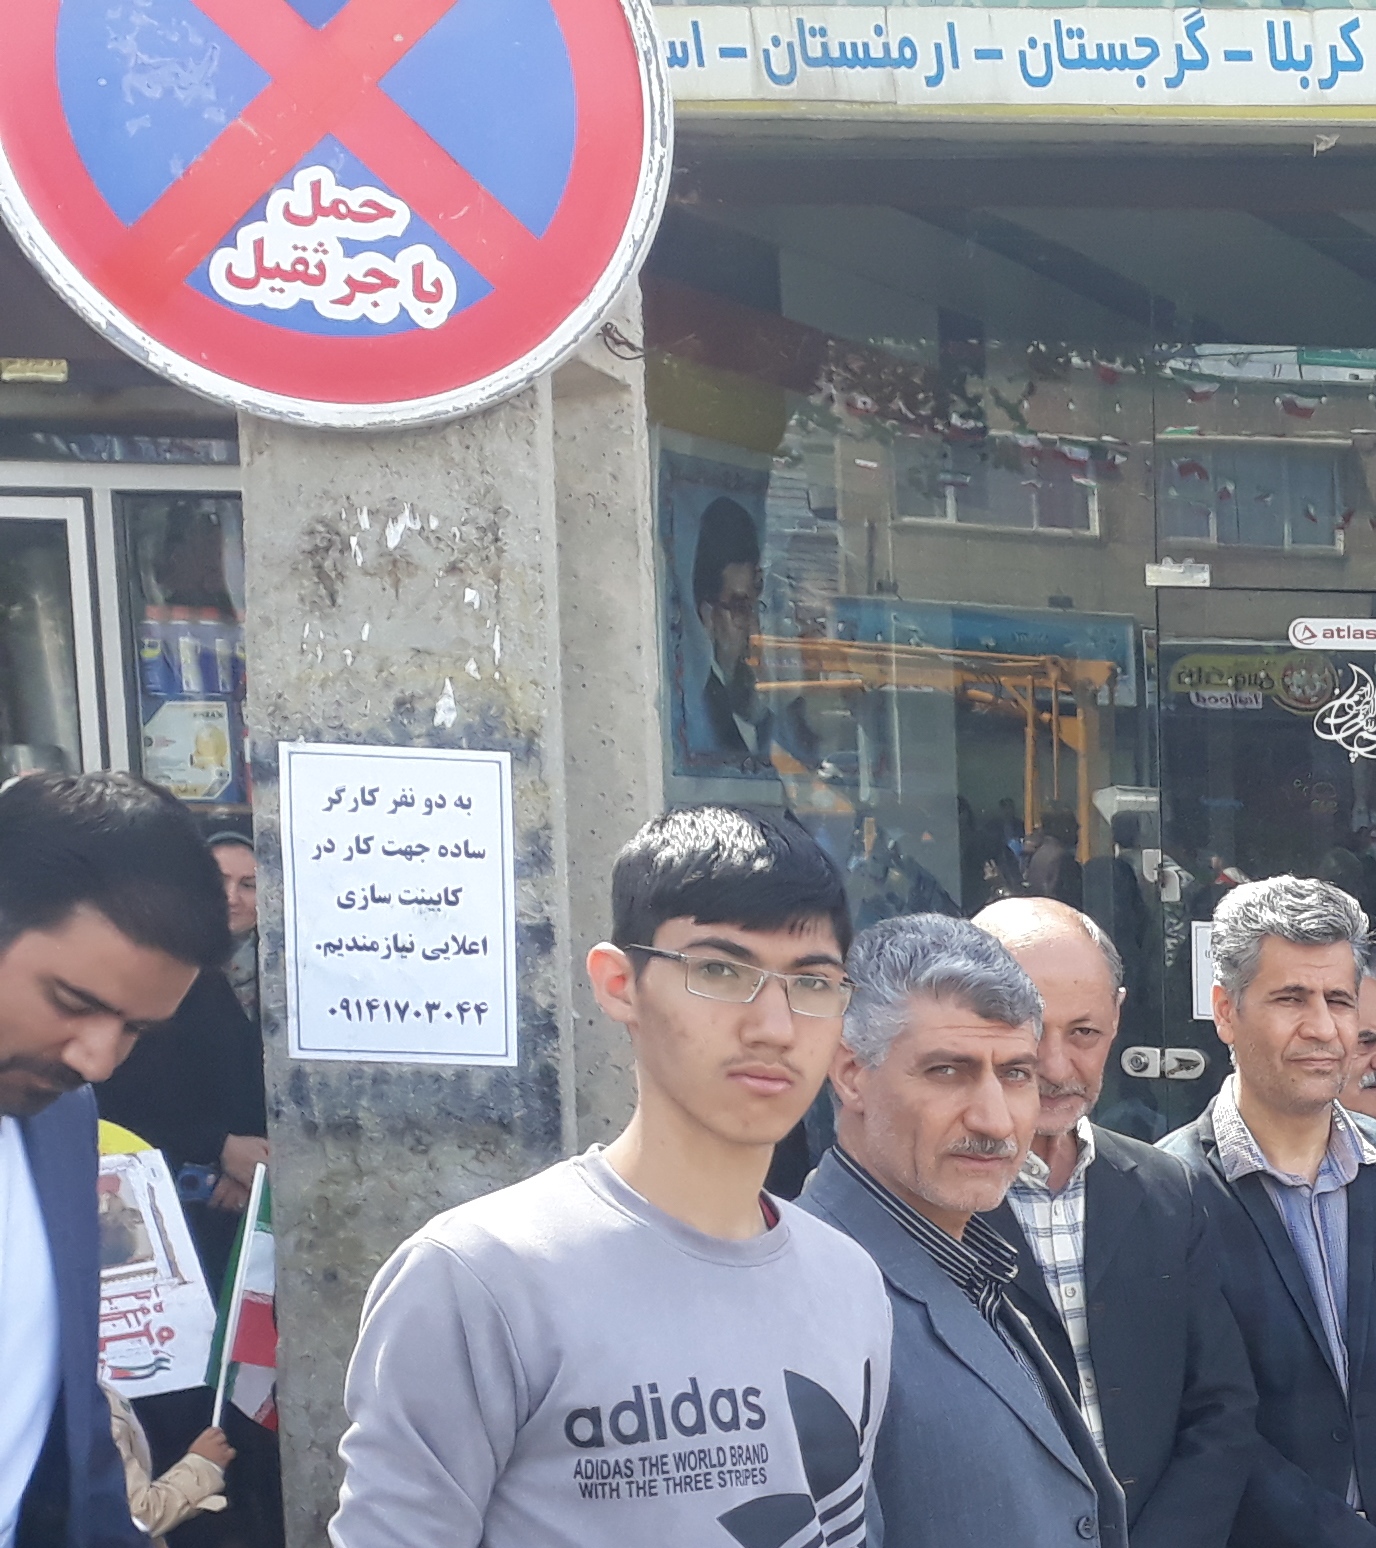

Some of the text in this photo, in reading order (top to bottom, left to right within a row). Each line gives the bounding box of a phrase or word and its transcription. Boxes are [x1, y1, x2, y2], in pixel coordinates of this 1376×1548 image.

[763, 17, 958, 88] ارمنستان
[1019, 9, 1210, 89] گرجستان
[1267, 18, 1365, 91] کربلا
[282, 178, 396, 227] حمل
[225, 236, 445, 315] با جر ثقیل
[322, 786, 473, 816] به دو نفر کارگر
[311, 834, 486, 863] ساده جهت کار در
[336, 884, 463, 912] کابینت سازی
[421, 935, 488, 960] اعلایی
[328, 997, 489, 1026] ۰۹۱۴۱۷۰۳۰۴۴
[565, 1376, 766, 1448] adidas
[573, 1442, 769, 1481] ADIDAS THE WORLD BRAND
[578, 1467, 768, 1500] WITH THE THREE STRIPES
